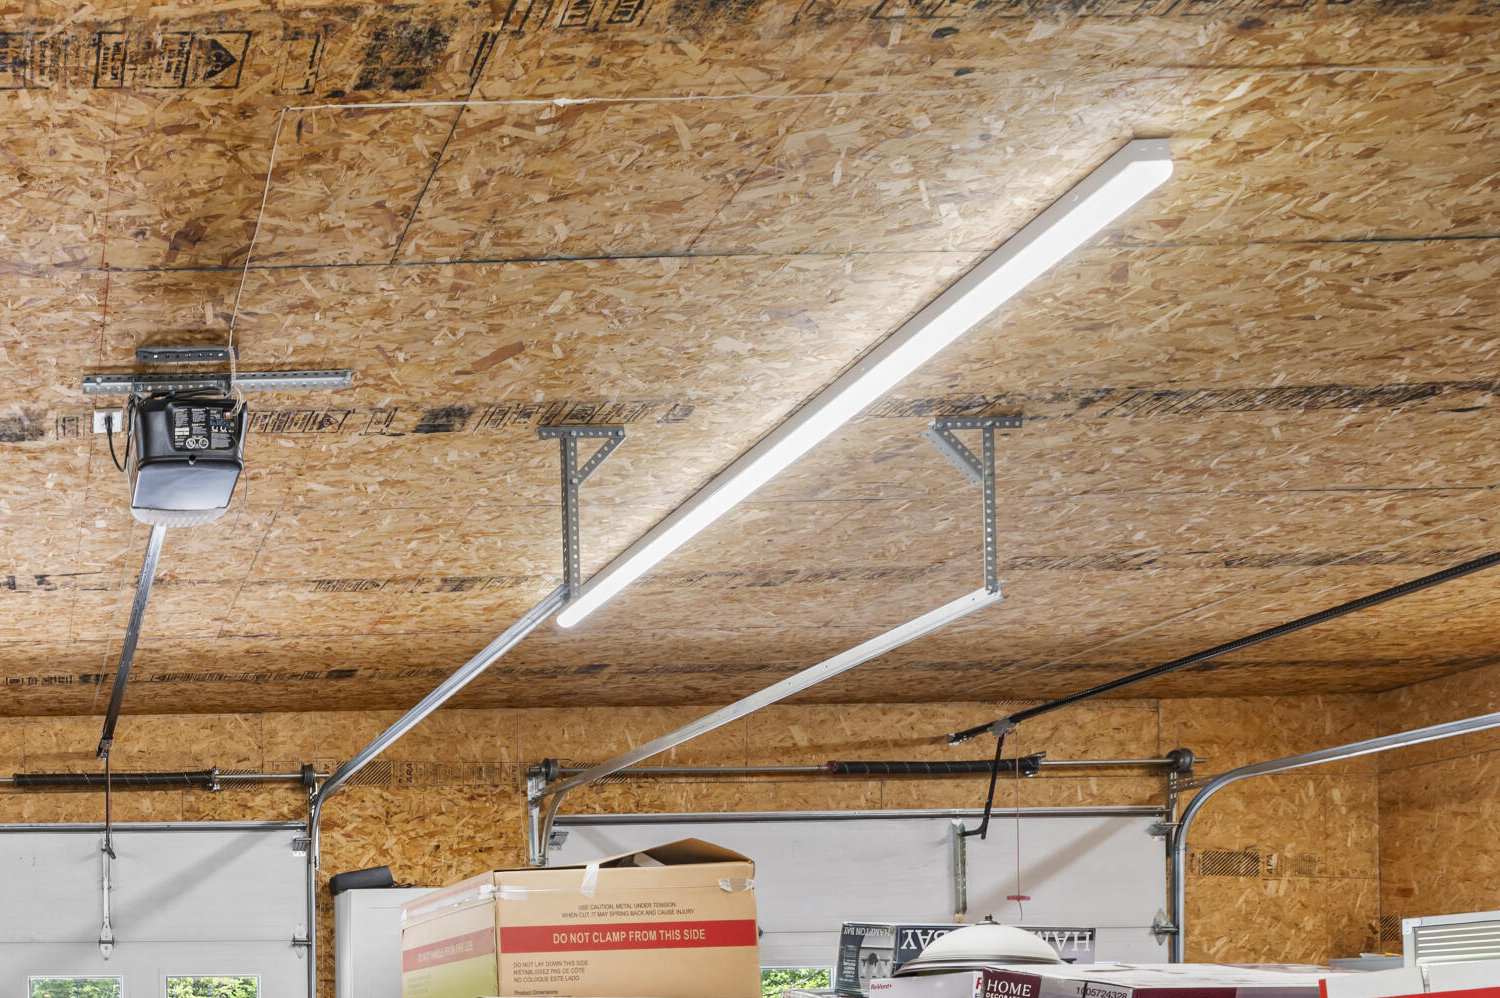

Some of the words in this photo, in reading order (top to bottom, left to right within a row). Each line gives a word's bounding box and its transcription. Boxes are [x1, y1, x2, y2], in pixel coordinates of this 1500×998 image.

[553, 932, 567, 944] DO
[569, 932, 589, 943] NOT
[592, 931, 626, 942] CLAMP
[628, 930, 656, 941] FROM
[658, 929, 681, 940] THIS
[683, 928, 705, 940] SIDE
[844, 927, 857, 936] BAY
[987, 979, 1032, 997] HOME
